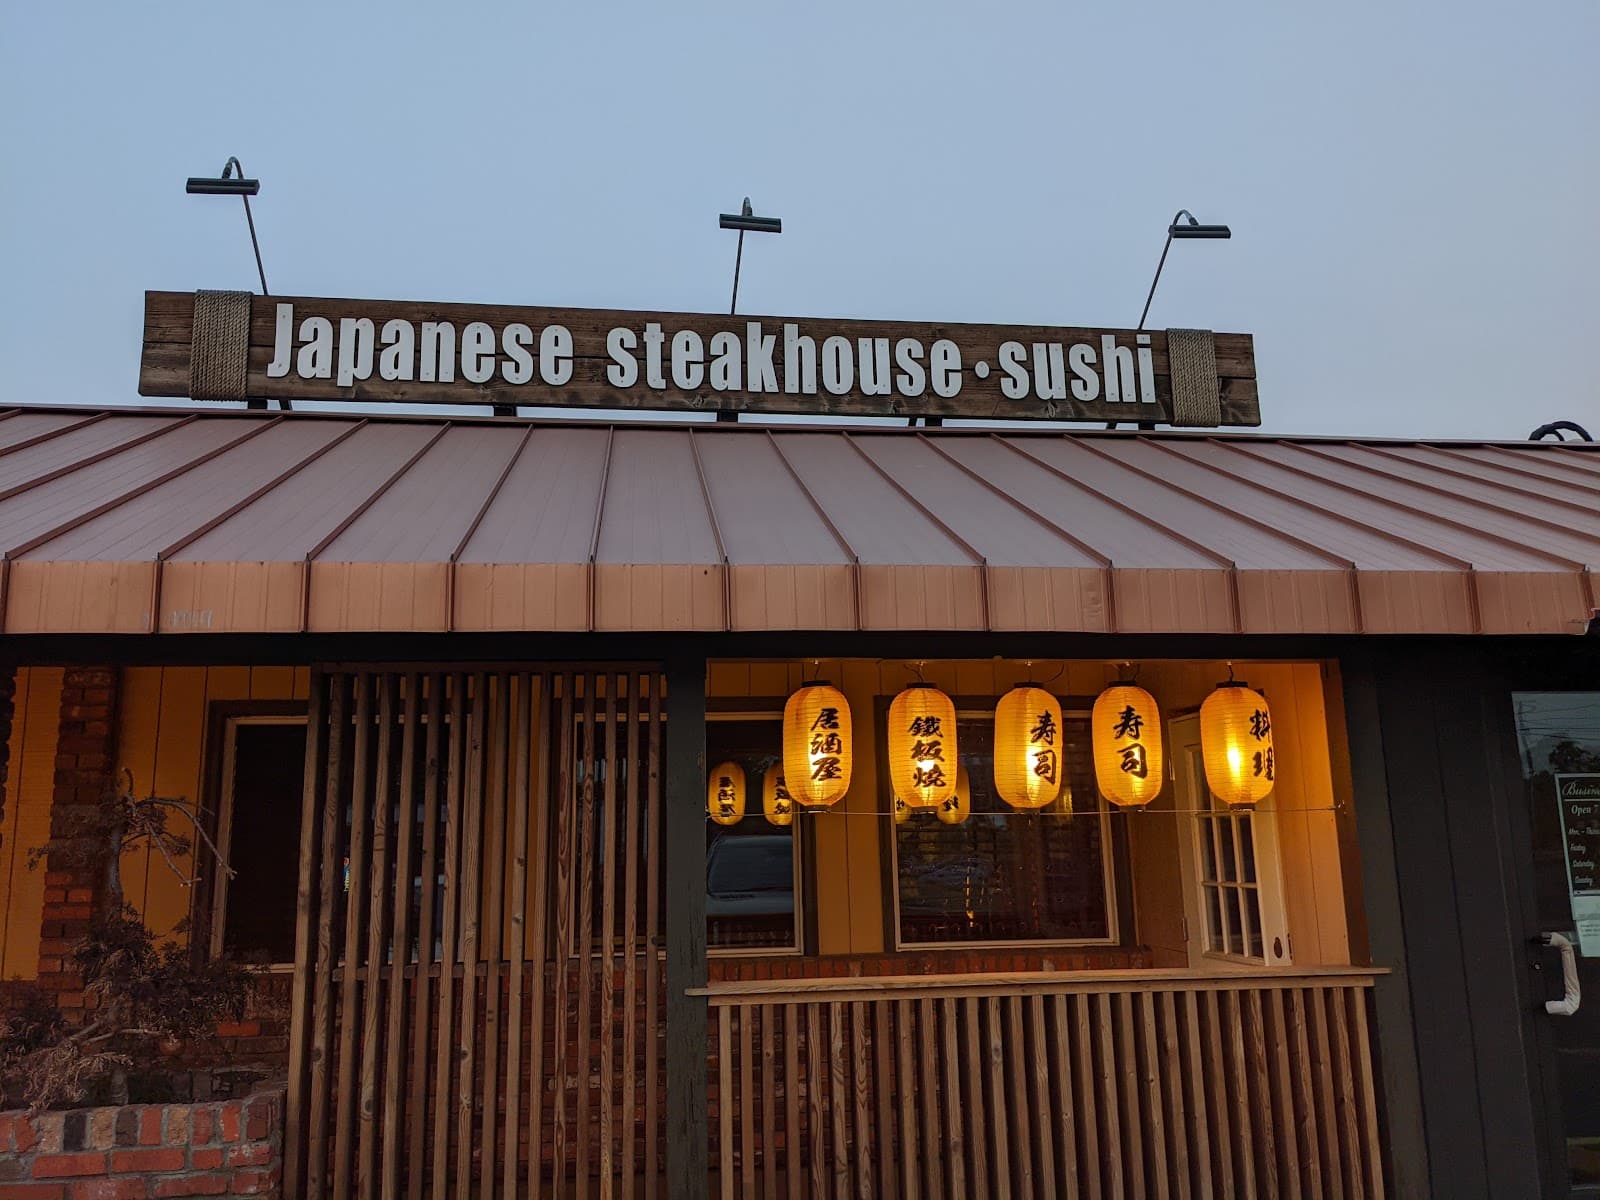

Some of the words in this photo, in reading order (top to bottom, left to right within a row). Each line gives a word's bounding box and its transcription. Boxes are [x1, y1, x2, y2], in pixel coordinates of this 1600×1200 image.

[267, 303, 573, 387] Japanese
[606, 321, 963, 399] steakhouse
[998, 334, 1156, 404] sushi
[810, 707, 842, 782] 居酒屋
[1030, 709, 1057, 785] 寿司
[1113, 705, 1148, 779] 寿司
[1571, 804, 1591, 816] Open
